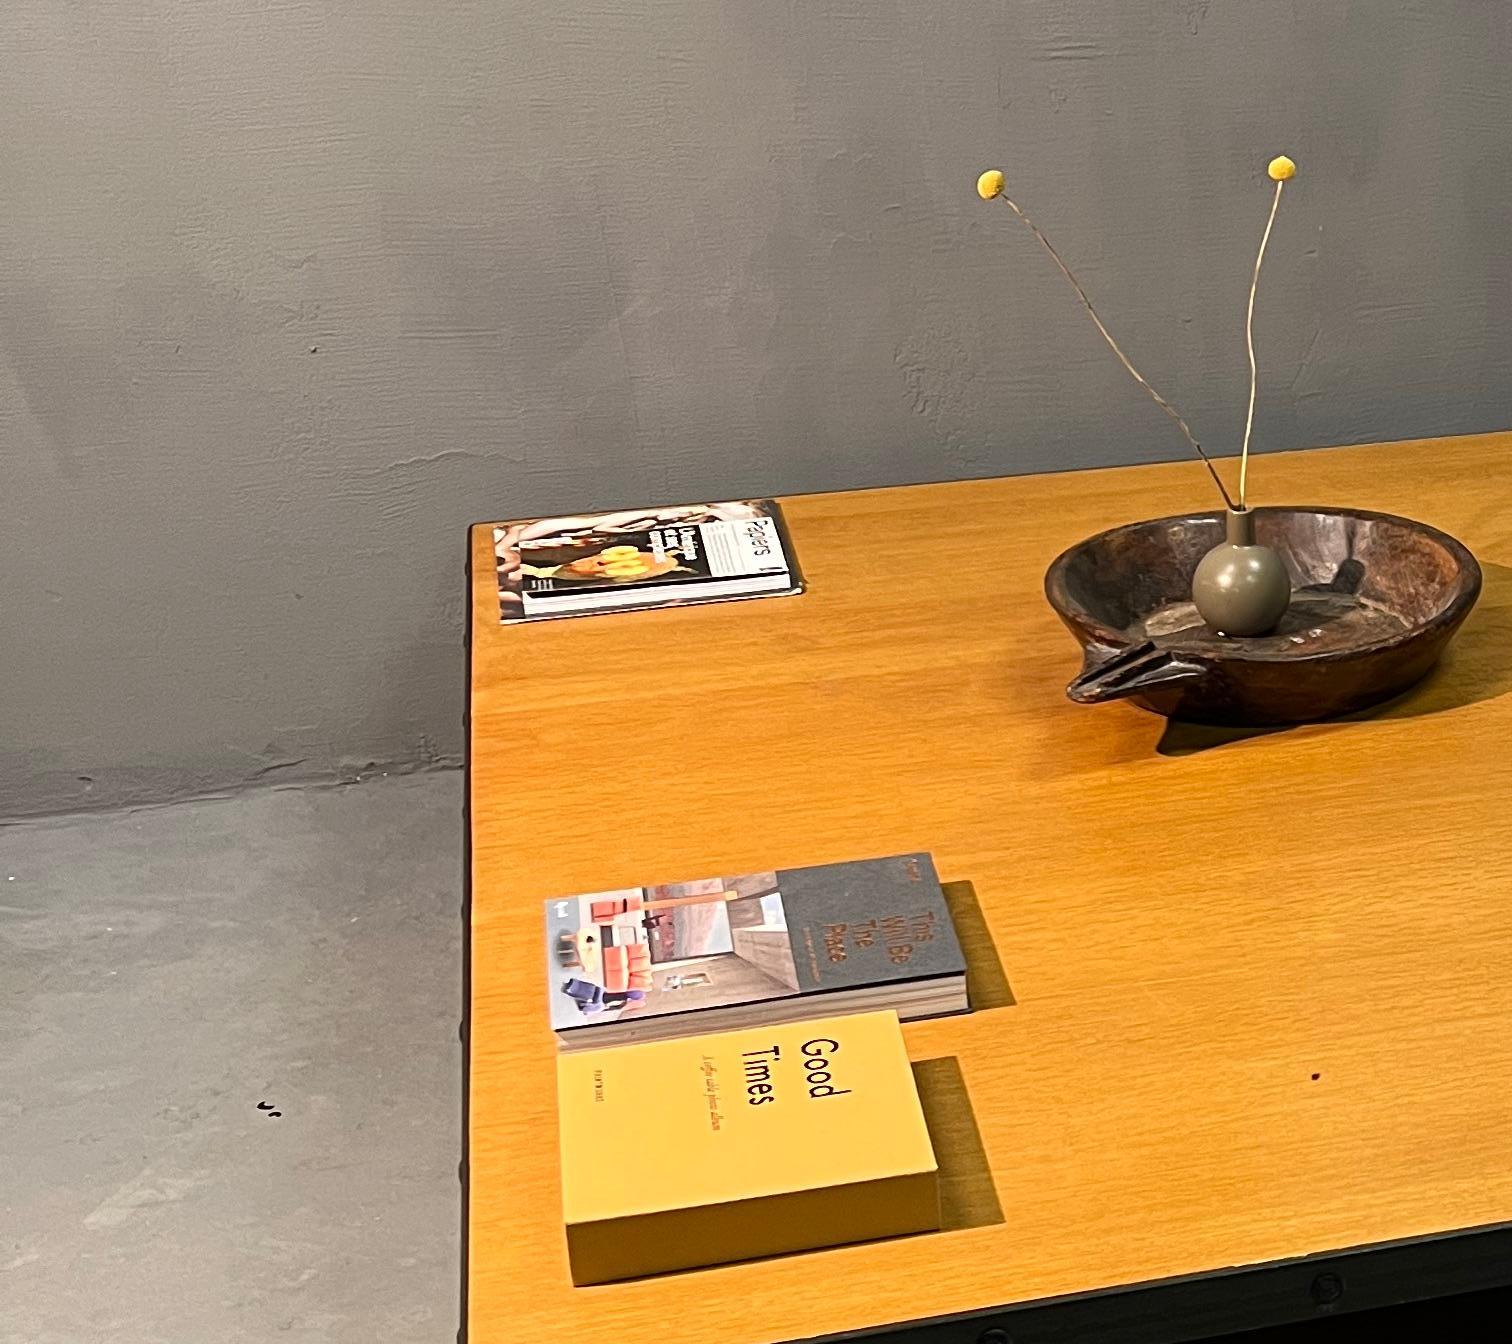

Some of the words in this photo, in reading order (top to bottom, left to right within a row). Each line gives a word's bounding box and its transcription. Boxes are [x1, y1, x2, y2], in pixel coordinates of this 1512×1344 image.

[850, 919, 879, 946] The
[742, 1045, 781, 1106] Times
[801, 1038, 852, 1098] Good
